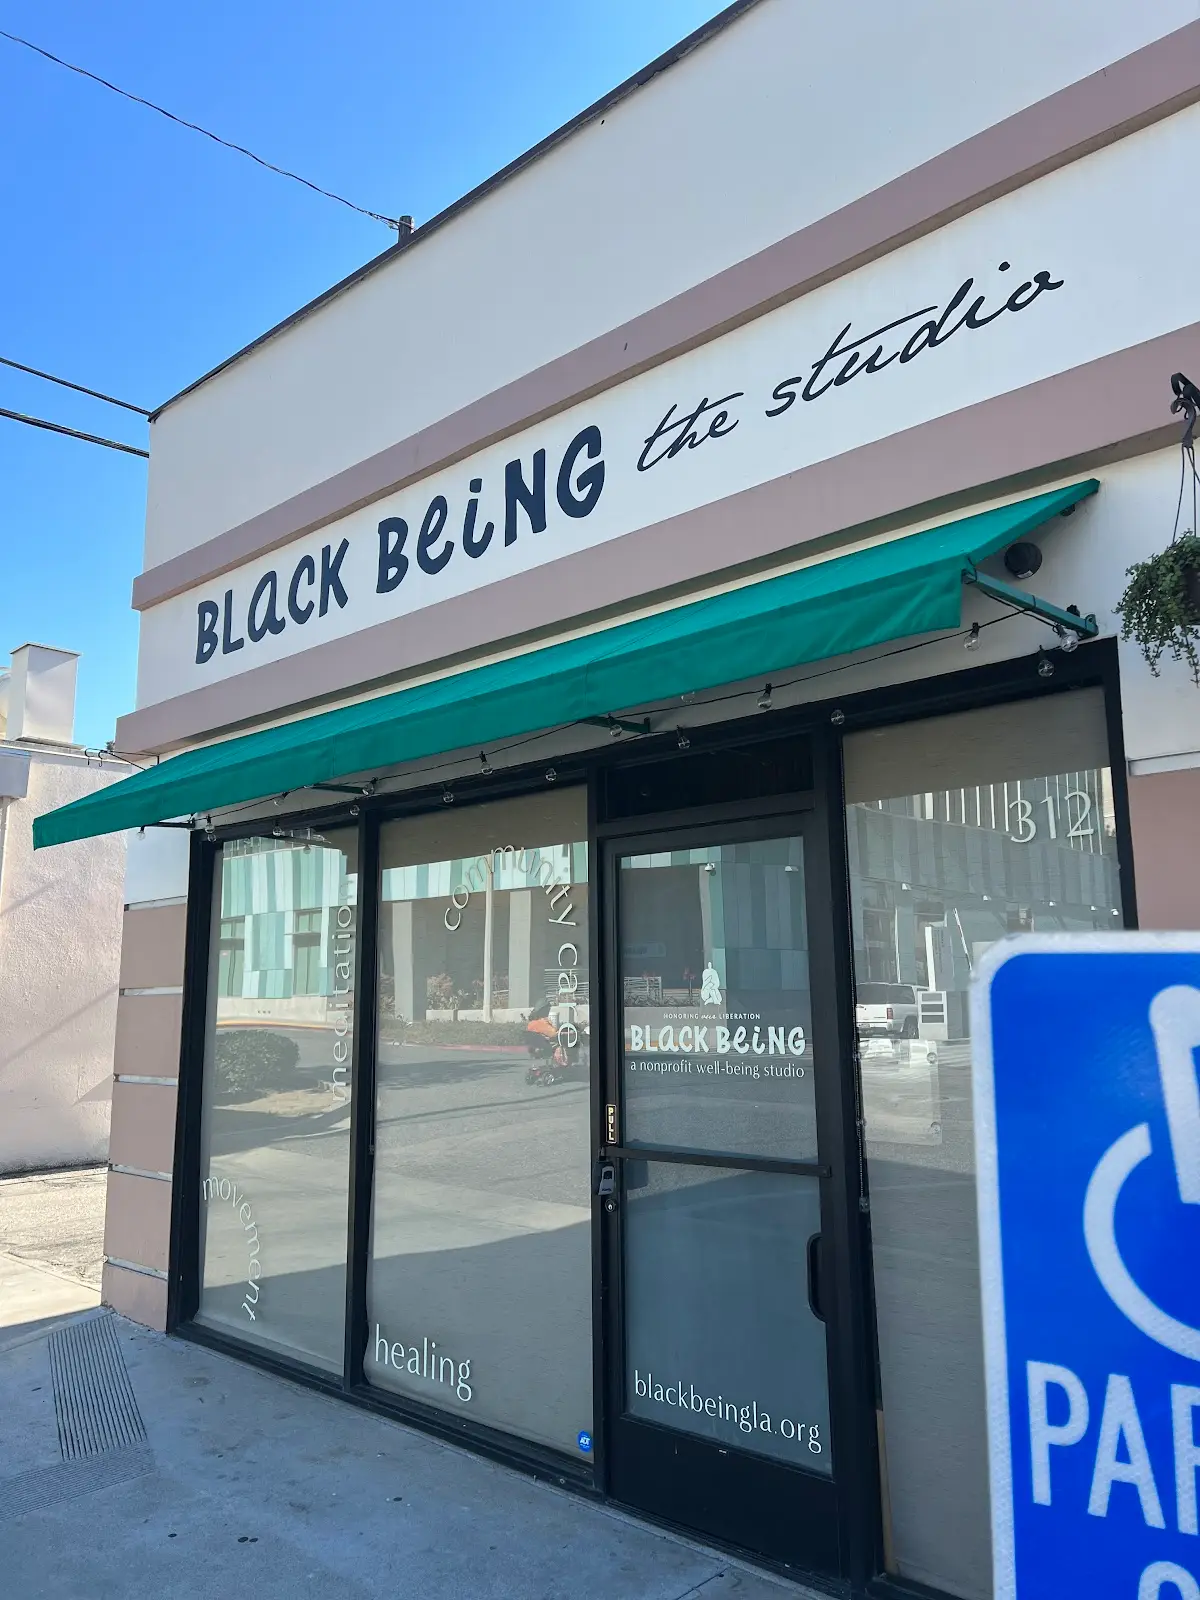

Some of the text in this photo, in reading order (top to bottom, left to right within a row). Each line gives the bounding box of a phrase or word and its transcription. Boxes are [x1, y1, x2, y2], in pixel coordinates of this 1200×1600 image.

[637, 391, 744, 472] the
[765, 261, 1064, 417] studio
[1009, 791, 1094, 843] 312
[444, 844, 578, 1048] community care
[630, 1059, 805, 1079] a nonprofit well-being studio
[203, 1176, 261, 1321] movement
[375, 1323, 472, 1402] healing
[635, 1369, 822, 1454] blackbeingla.org
